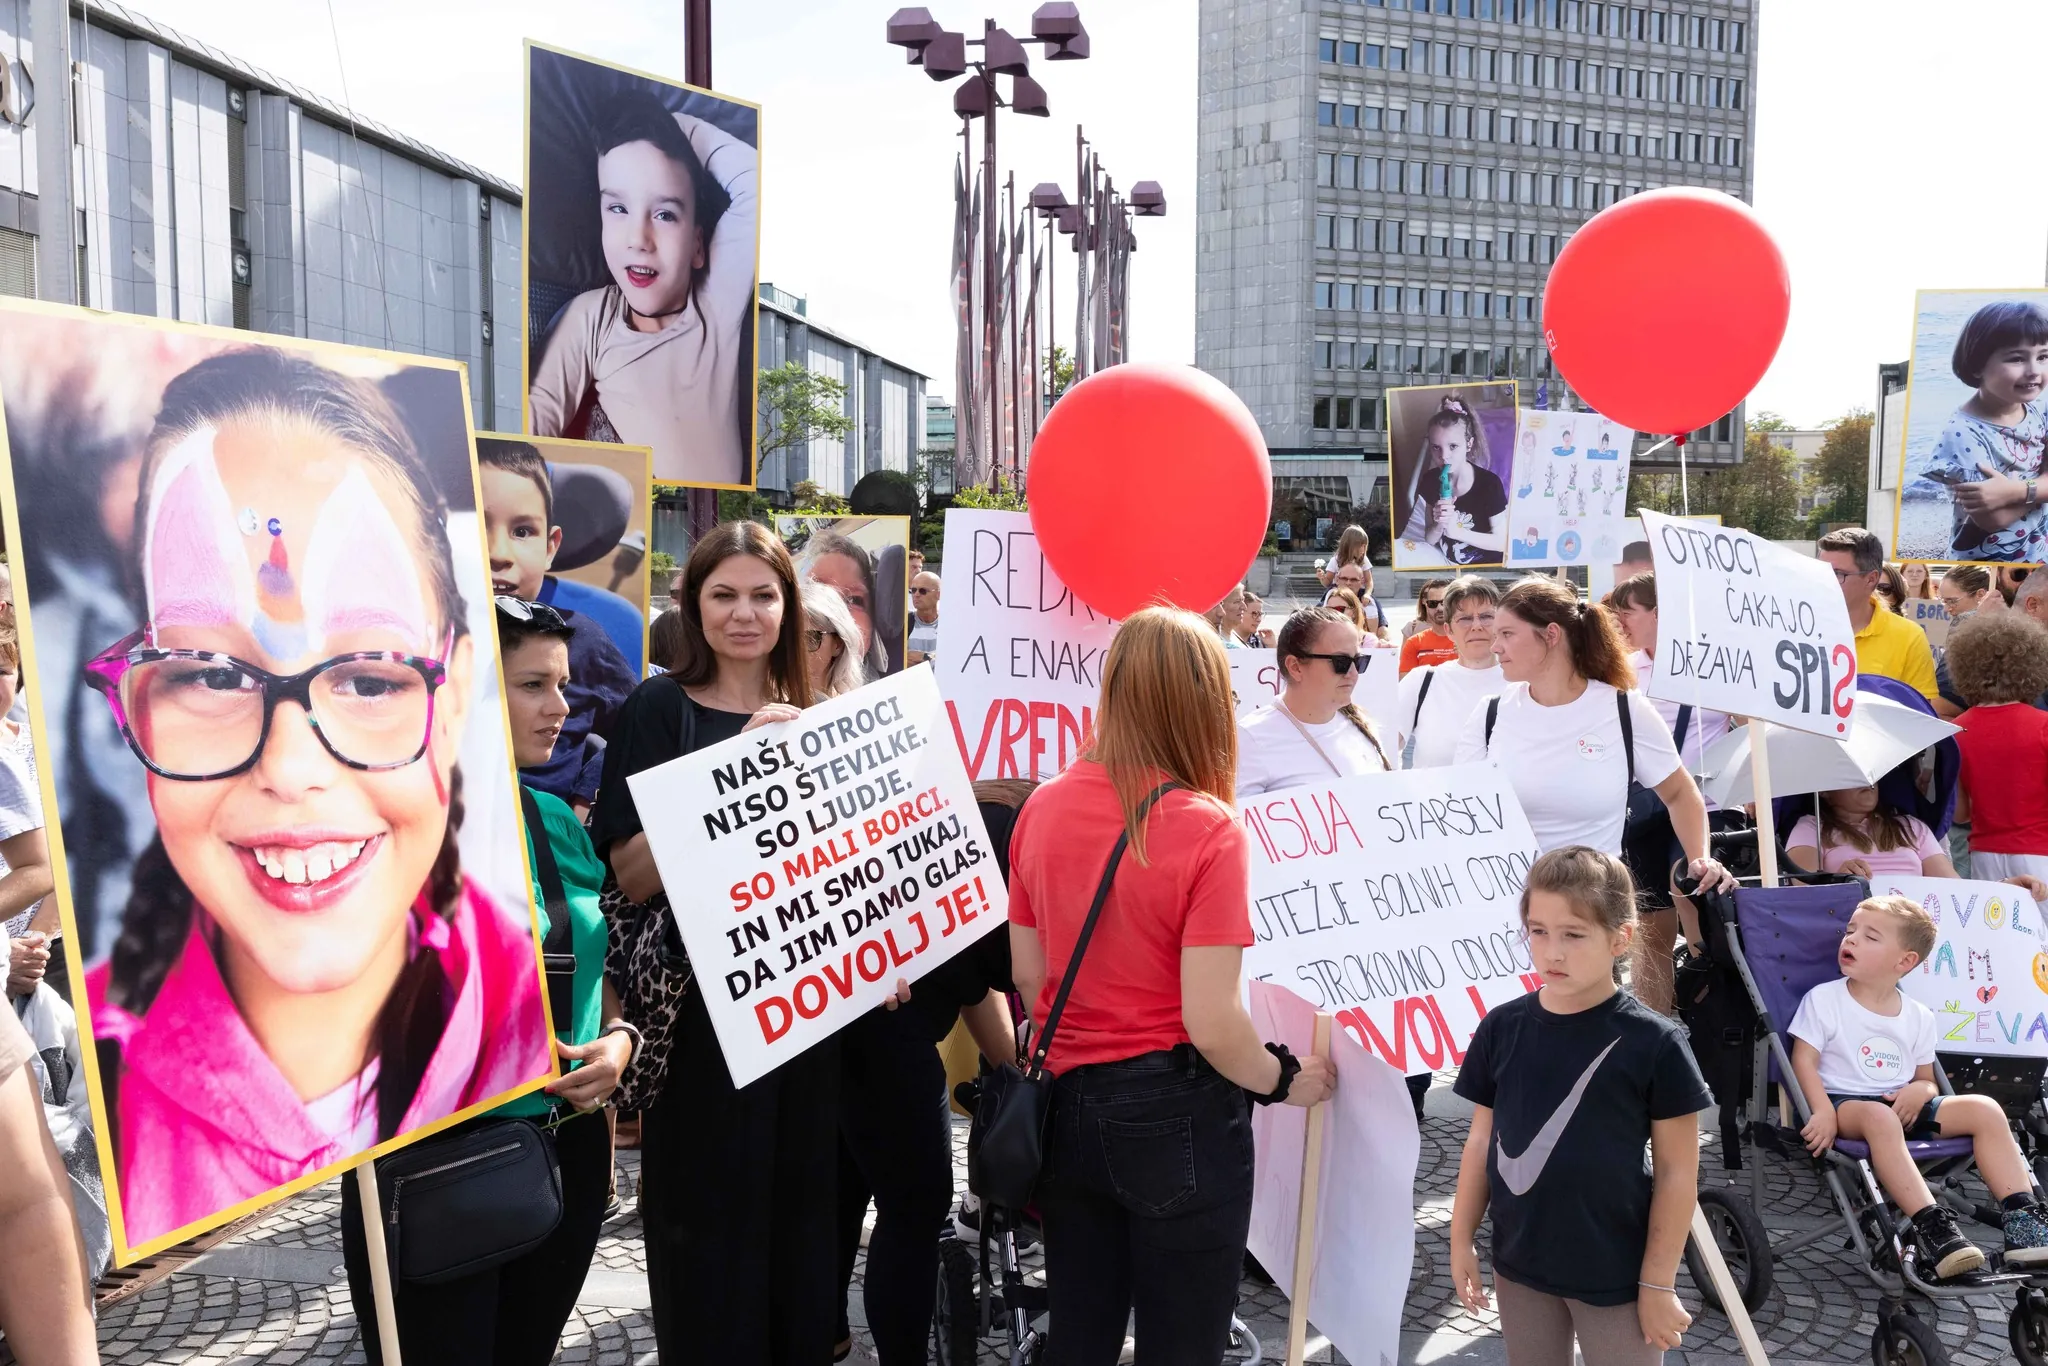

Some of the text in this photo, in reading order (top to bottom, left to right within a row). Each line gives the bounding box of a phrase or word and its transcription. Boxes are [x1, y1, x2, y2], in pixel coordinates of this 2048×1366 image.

[971, 529, 1111, 624] RED
[1661, 524, 1761, 578] OTROCI
[1725, 578, 1823, 640] ČAKAJO,
[961, 635, 1107, 688] A ENAK
[1670, 633, 1757, 690] DRŽAVA
[711, 696, 904, 796] NAŠI OTROCI
[702, 725, 929, 841] NISO ŠTEVILKE.
[755, 770, 913, 859] SO LJUDJE.
[729, 786, 950, 912] SO MALI BORCI.
[1378, 793, 1504, 843] STARŠEV
[726, 814, 970, 958] IN MI SMO TUKAJ,
[1255, 879, 1360, 943] JTEŽJE
[1365, 862, 1463, 921] BOLNIH
[725, 840, 988, 1002] DA JIM DAMO GLAS.
[753, 875, 991, 1046] DOVOLJ JE!
[1296, 944, 1446, 1008] STROKOVNO
[1922, 940, 1994, 982] AM
[1939, 1000, 2048, 1045] ŽEVA
[1874, 1051, 1901, 1062] VIDOVA
[1886, 1061, 1900, 1069] POT
